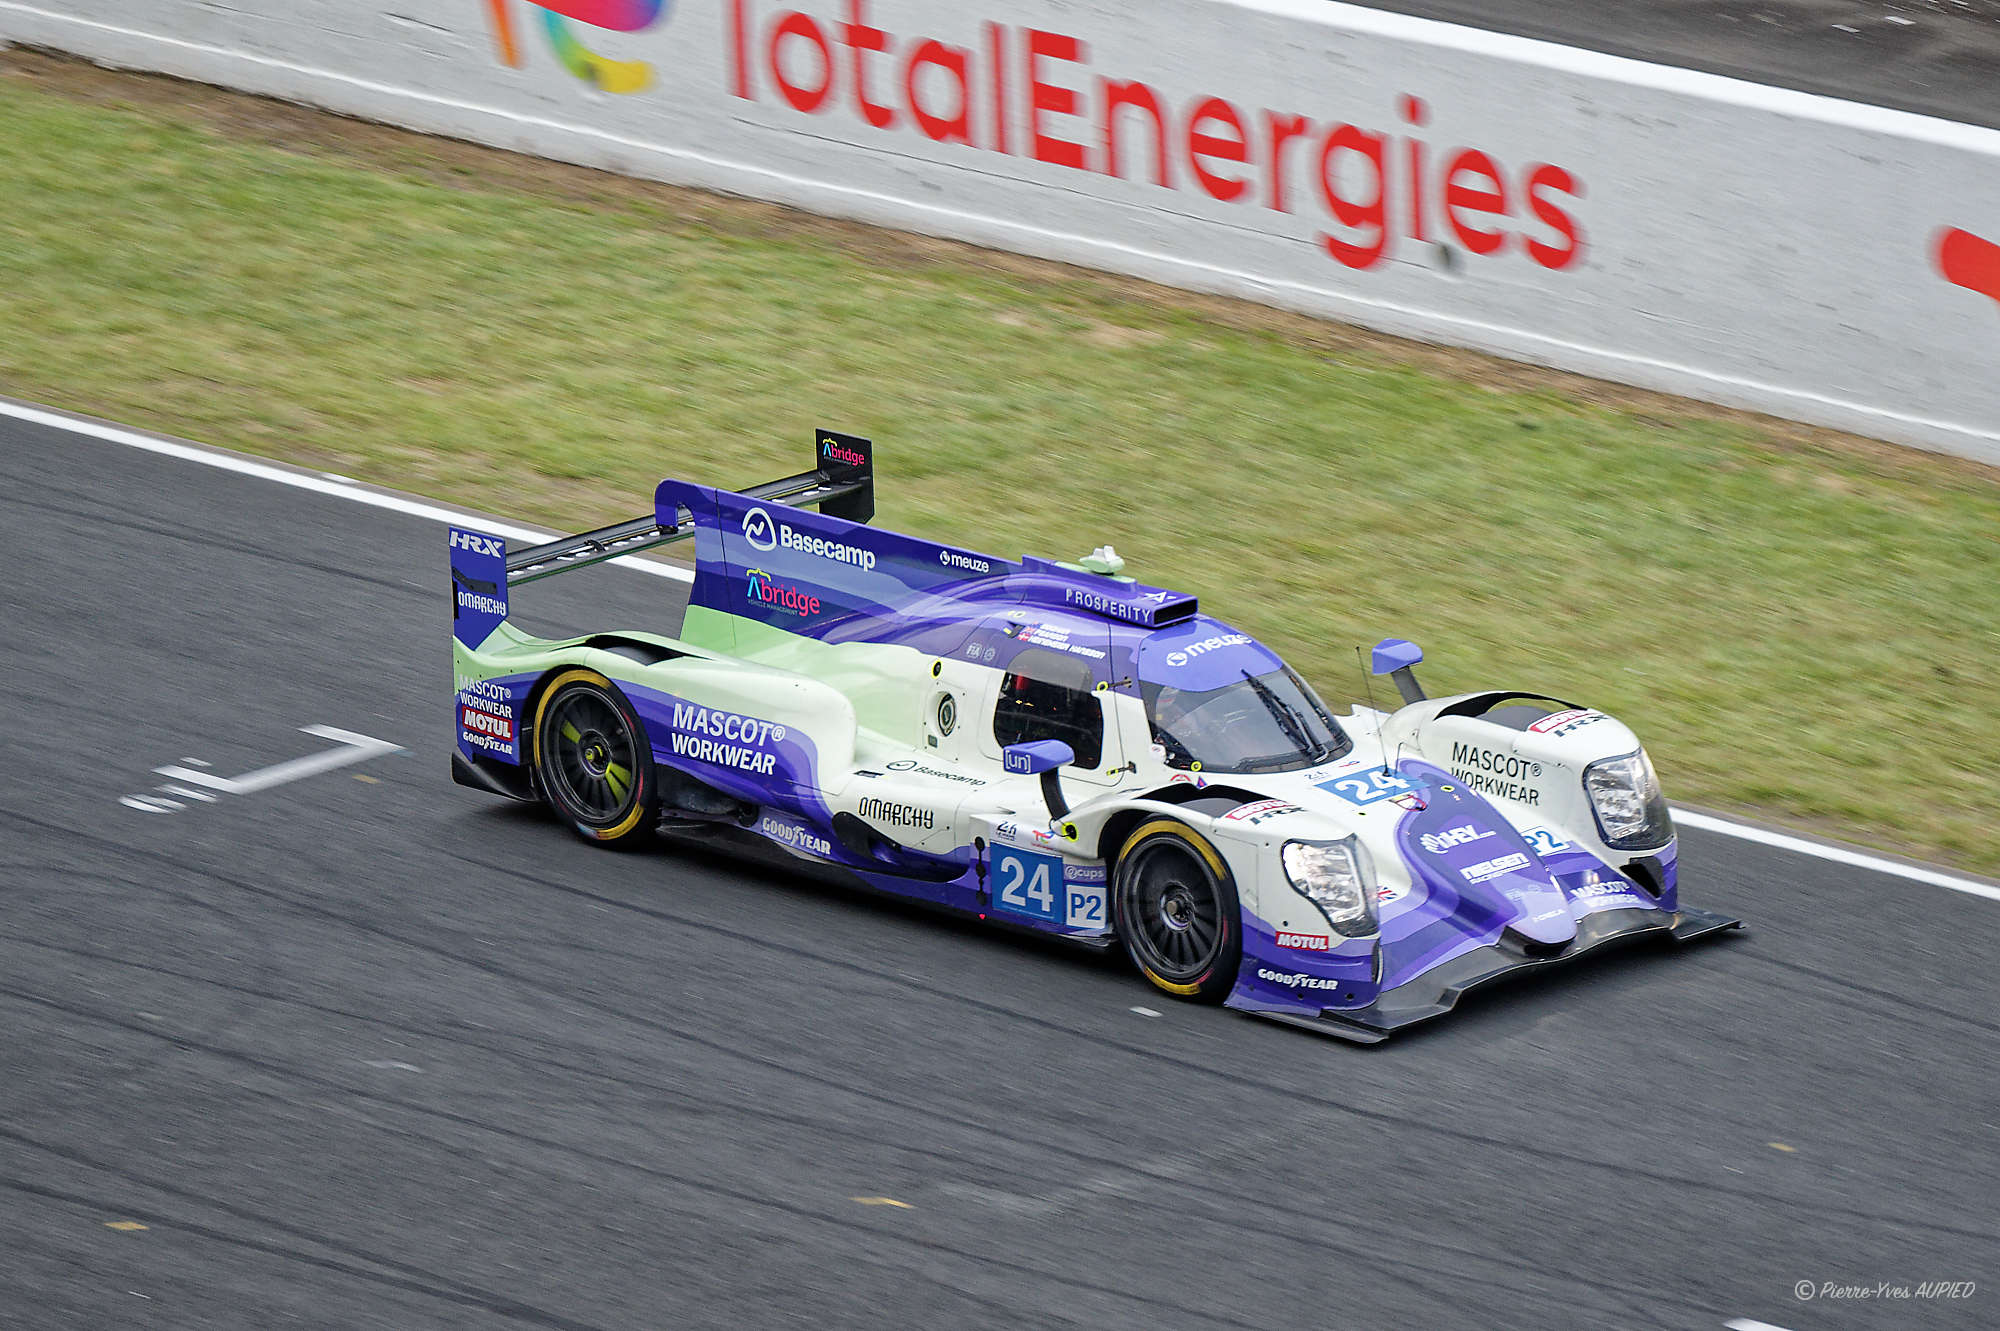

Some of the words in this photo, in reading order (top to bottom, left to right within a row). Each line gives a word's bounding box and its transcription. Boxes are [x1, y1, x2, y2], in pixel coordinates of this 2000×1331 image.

[823, 438, 865, 467] Abridge
[449, 531, 503, 558] HRX
[779, 524, 876, 571] Basecamp
[951, 553, 990, 574] meuze
[457, 592, 507, 617] OMARCHY
[746, 568, 821, 617] Abridge
[1065, 588, 1151, 623] PROSPERITY
[1184, 634, 1253, 658] meuze
[460, 691, 513, 719] WORKWEAR
[464, 709, 511, 739] MOTUL
[673, 703, 786, 748] MASCOT®
[463, 731, 513, 755] GOODYEAR
[672, 733, 776, 776] WORKWEAR
[1452, 741, 1543, 780] MASCOT®
[914, 766, 987, 786] Basecamp
[1335, 770, 1411, 801] 24
[1451, 766, 1540, 807] WORKWEAR
[859, 796, 934, 829] OMARCHY
[763, 816, 831, 856] GOODYEAR
[1001, 856, 1054, 912] 24
[1070, 892, 1102, 922] P2
[1277, 933, 1328, 950] MOTUL
[1258, 968, 1339, 991] GOODYEAR
